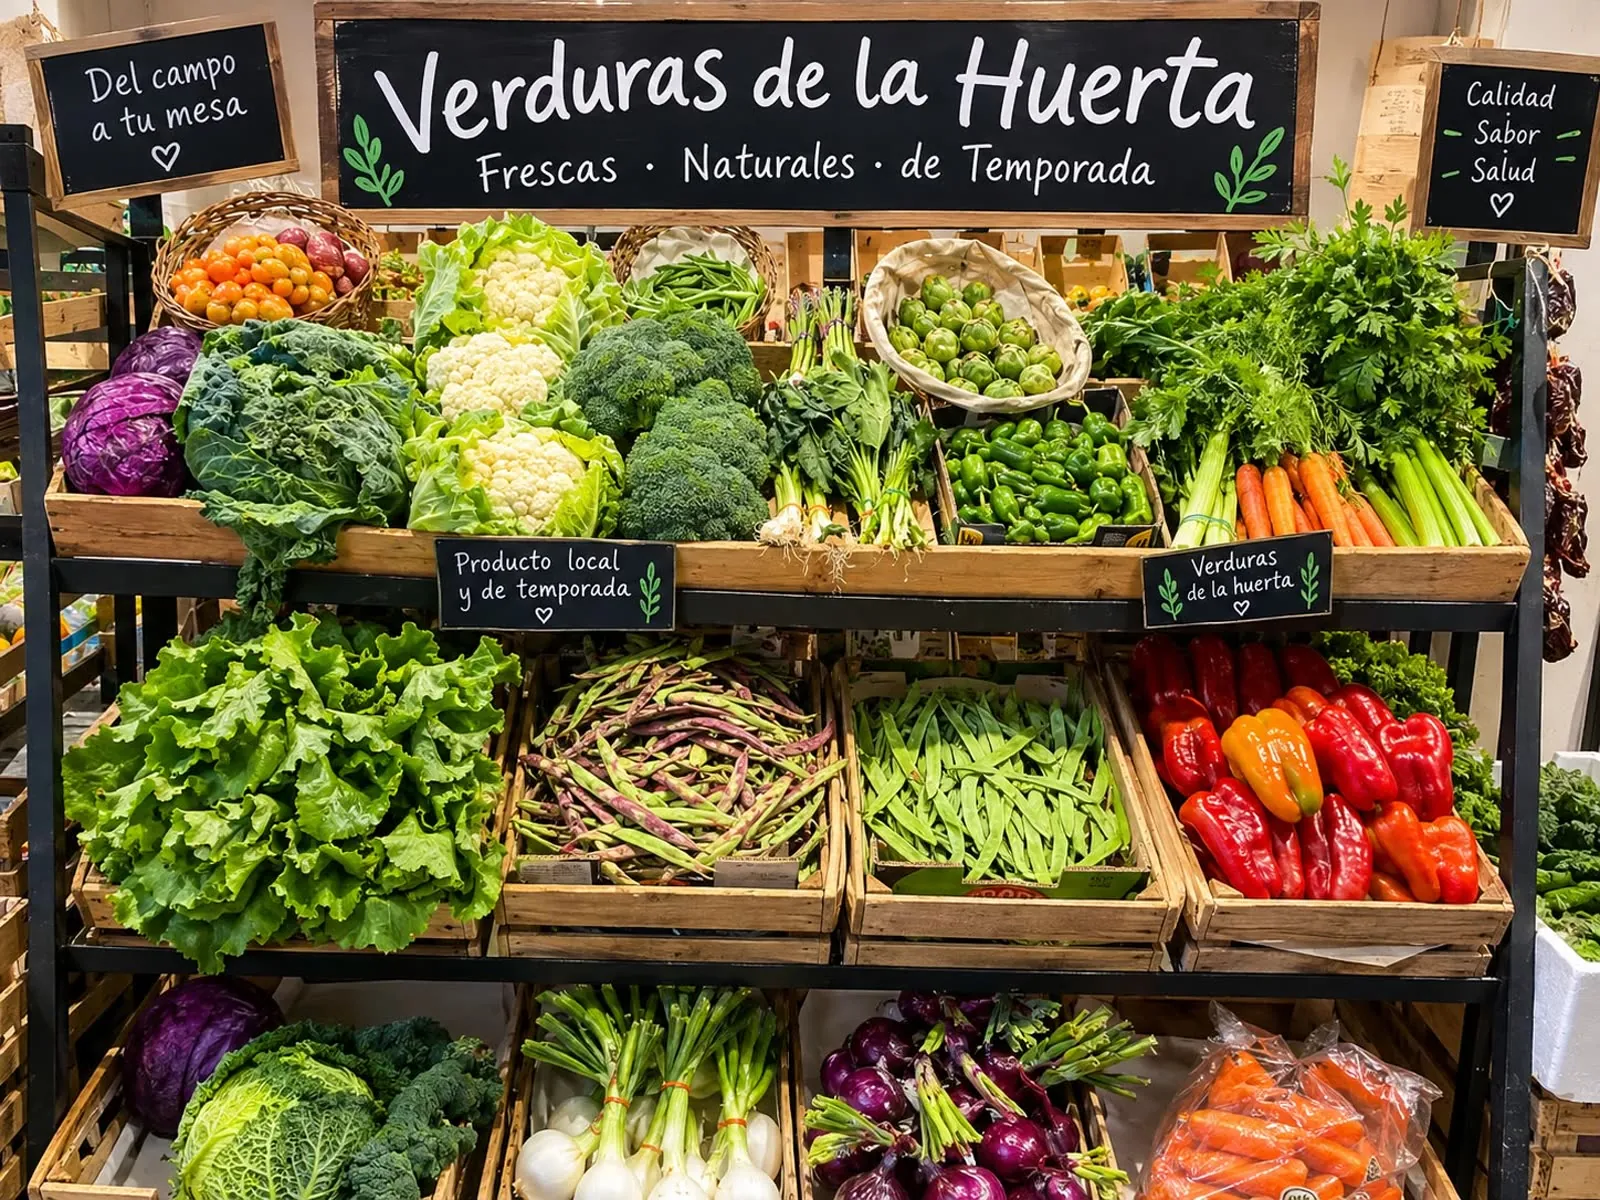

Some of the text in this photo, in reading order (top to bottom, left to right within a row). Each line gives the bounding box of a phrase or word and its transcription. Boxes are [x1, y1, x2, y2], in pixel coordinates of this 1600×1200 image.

[84, 54, 236, 103] Del campo
[374, 35, 1256, 154] Verduras de la Huerta
[1467, 80, 1557, 110] Calidad
[92, 96, 248, 142] a tu mesa
[1474, 119, 1541, 145] Sabor
[475, 140, 1156, 197] Frescas Naturales de Temporada
[1471, 156, 1537, 184] Salud
[454, 547, 621, 576] Producto local
[1190, 550, 1278, 577] Verduras
[459, 576, 632, 612] y de temporada
[1187, 570, 1295, 601] de la huerta
